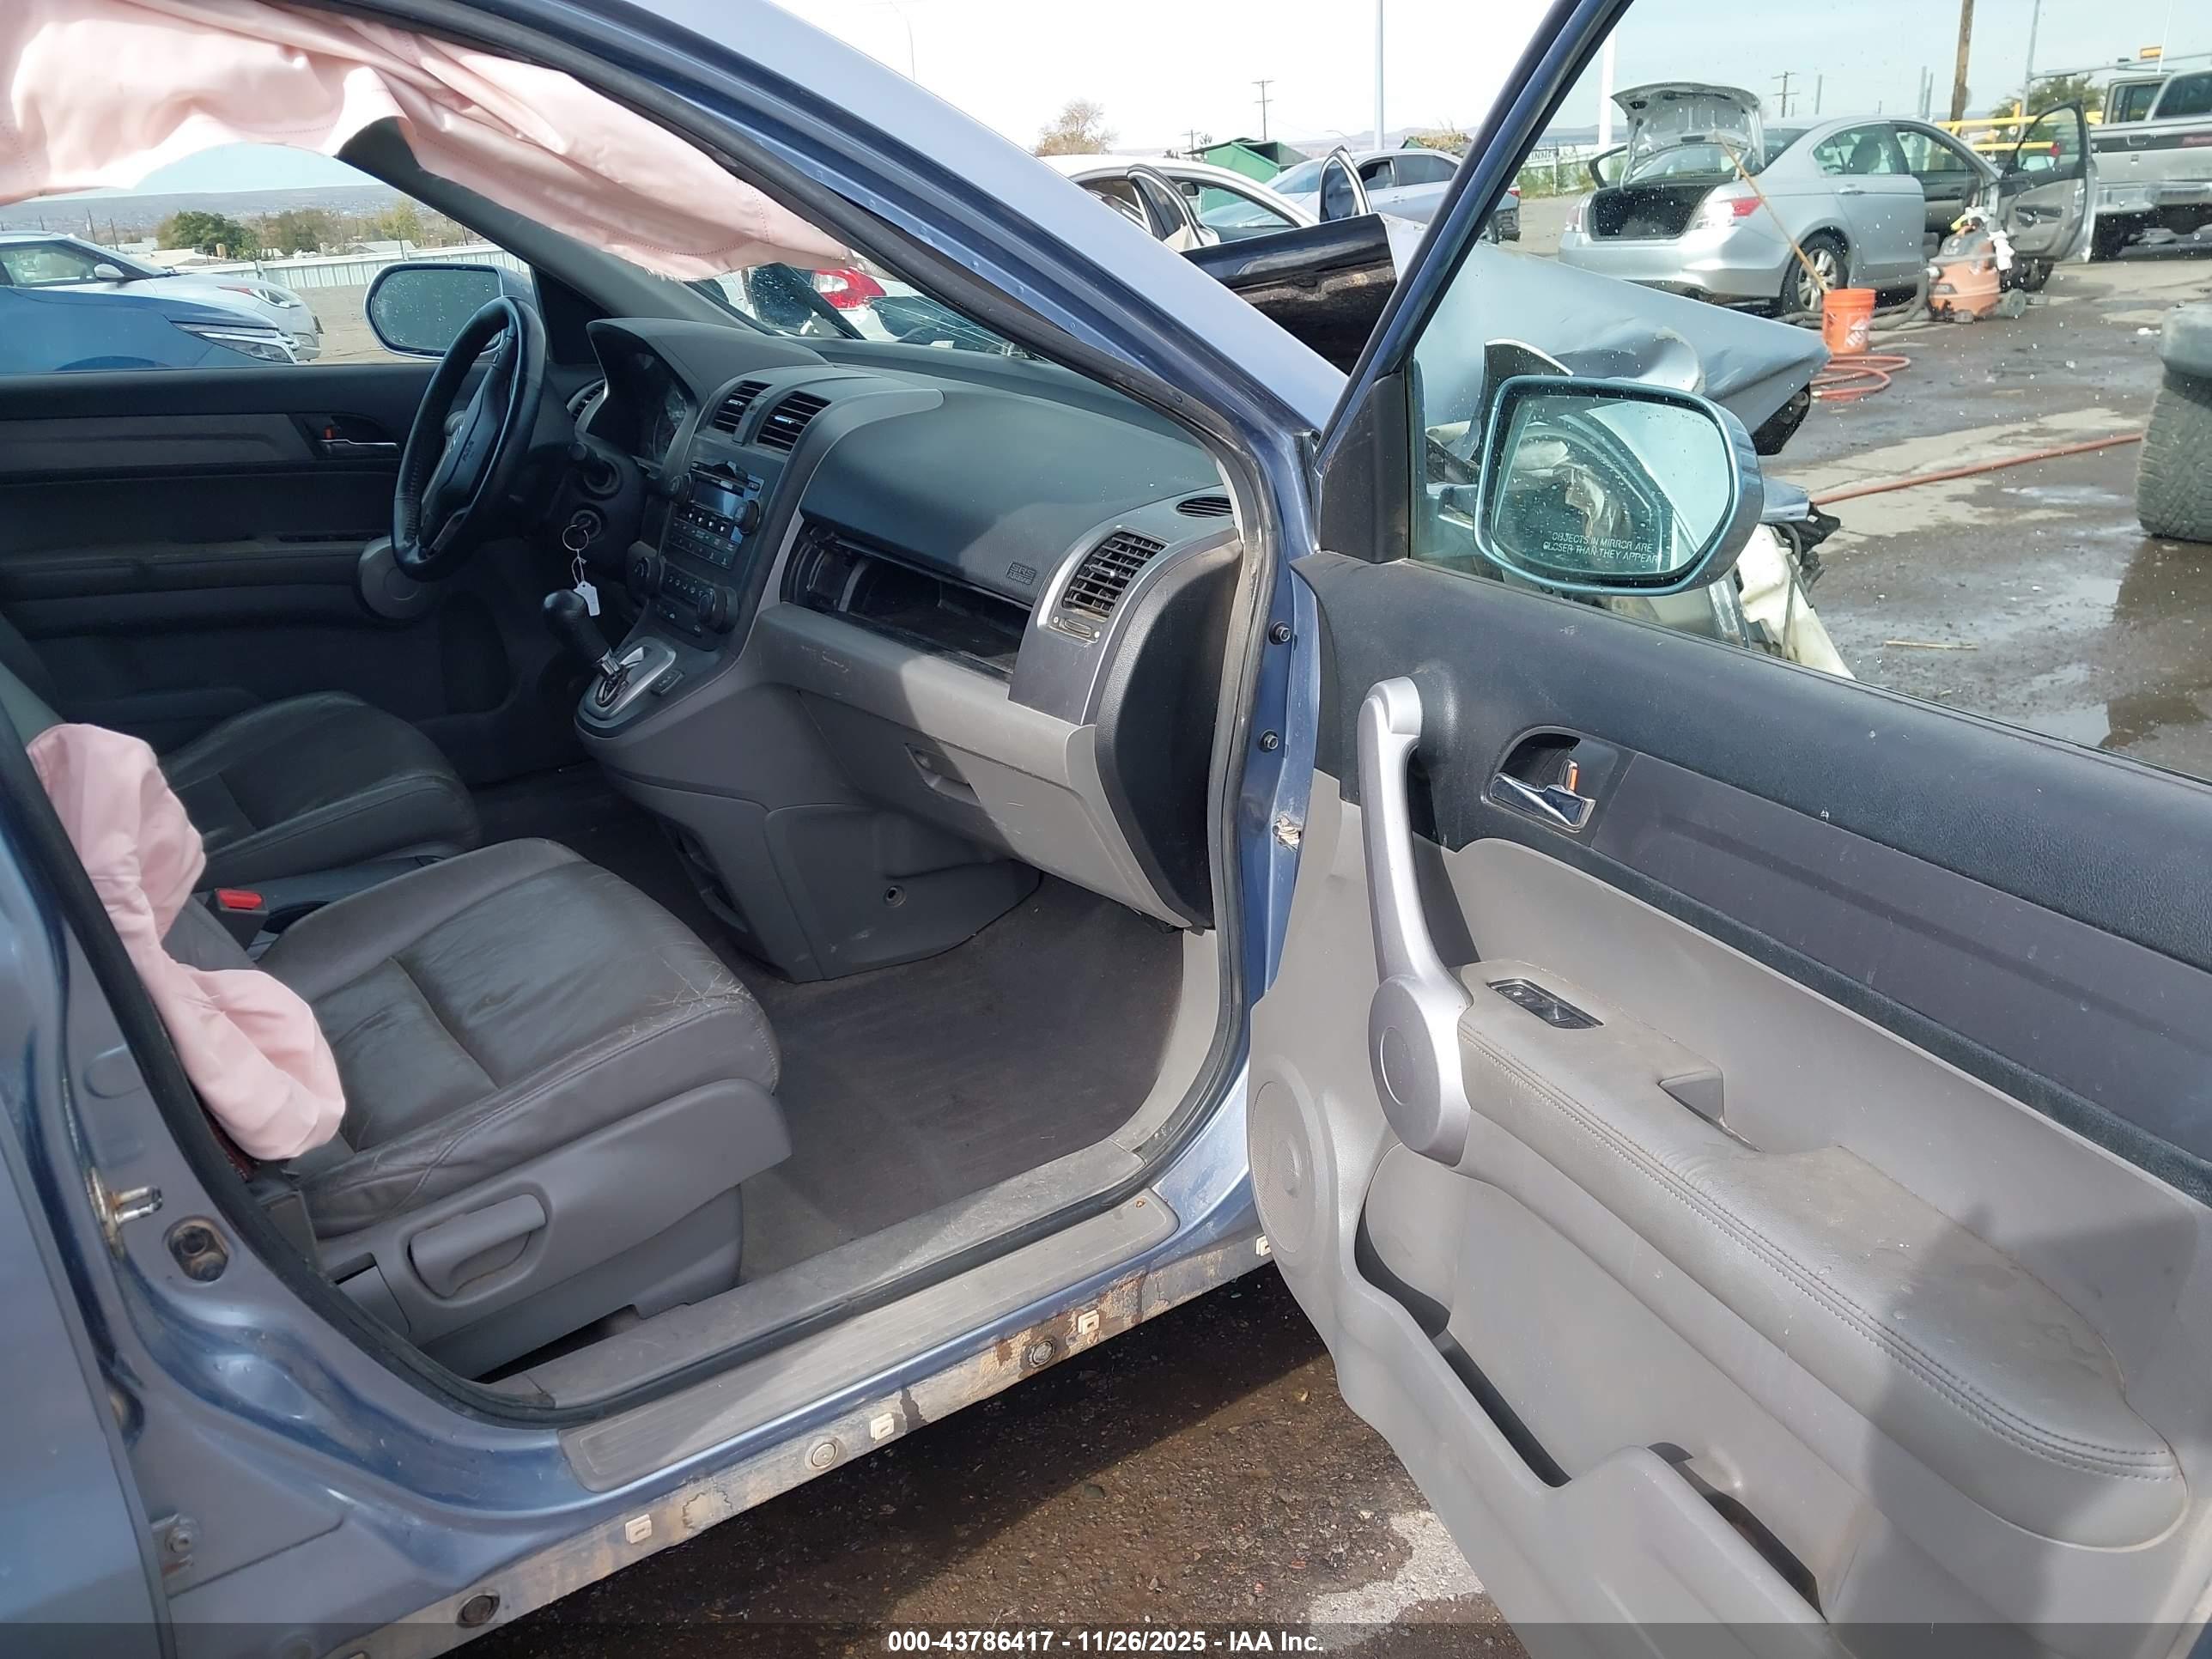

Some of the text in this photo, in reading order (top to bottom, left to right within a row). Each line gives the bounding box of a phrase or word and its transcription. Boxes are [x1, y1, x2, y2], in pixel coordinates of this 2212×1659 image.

[1543, 541, 1658, 564] CLOSER THAN THEY APPEAR
[1552, 532, 1654, 553] OBJECTS IN MIRROR ARE
[1010, 563, 1036, 577] SRS
